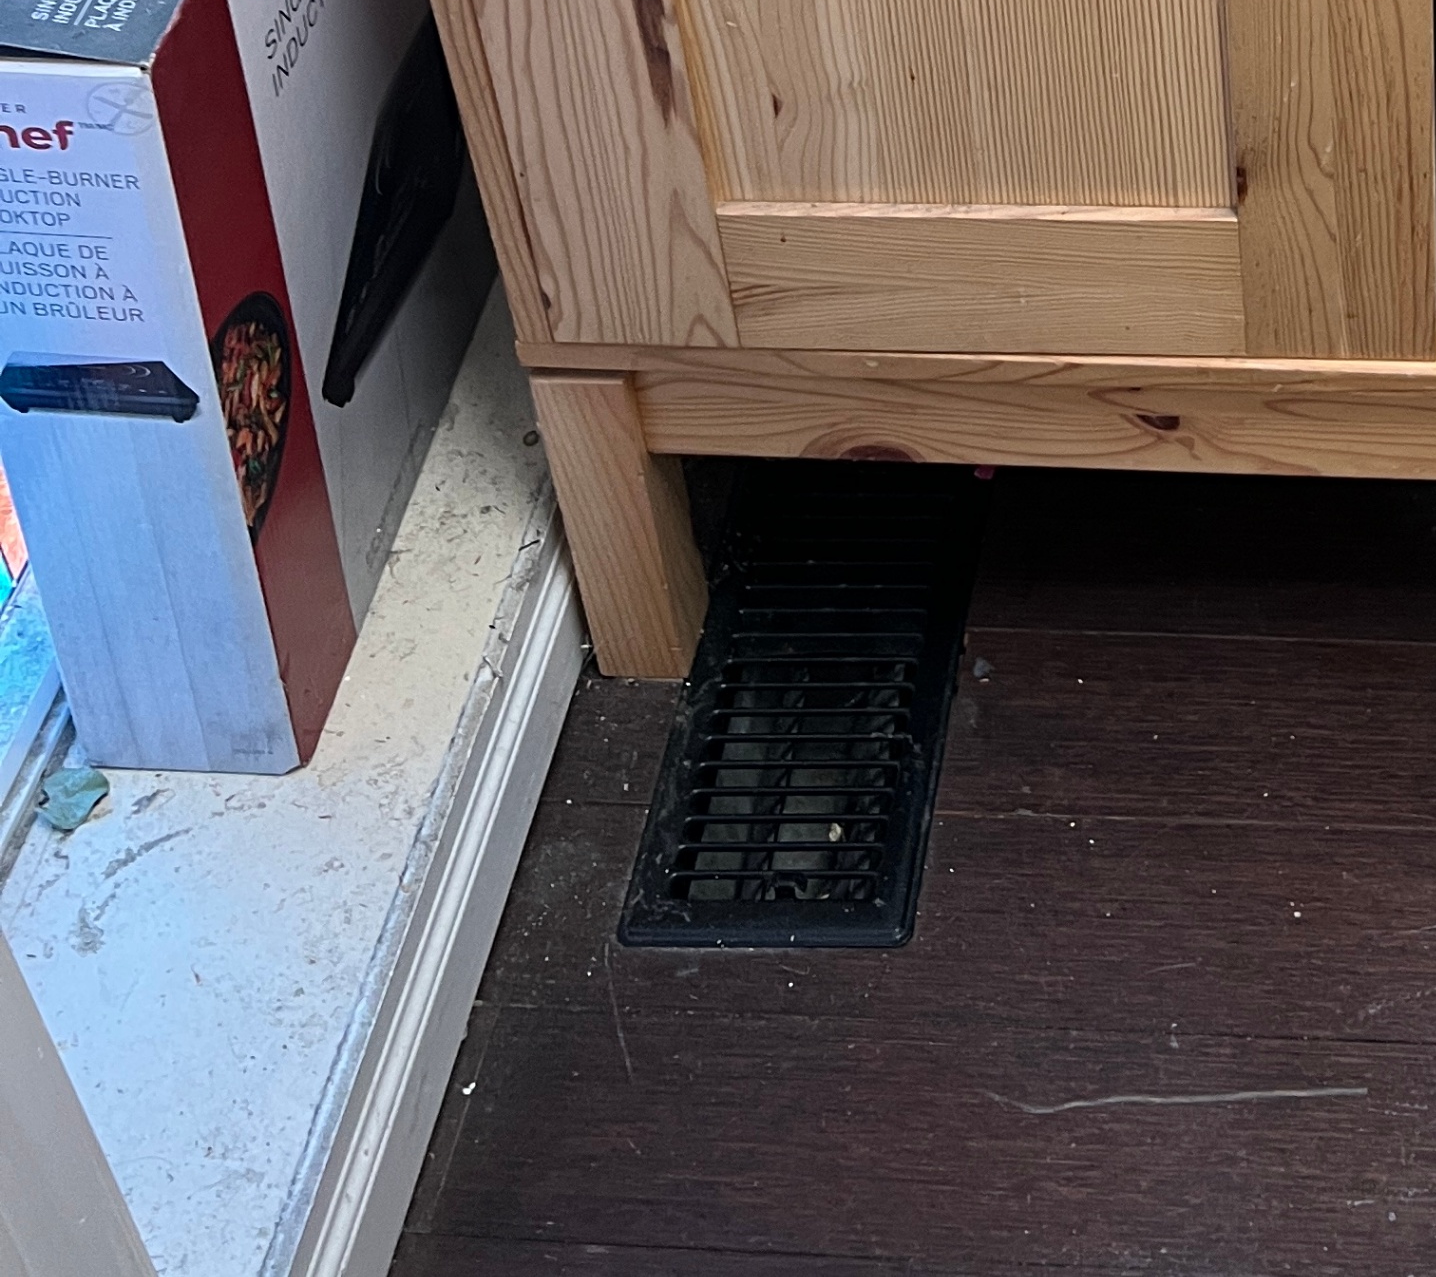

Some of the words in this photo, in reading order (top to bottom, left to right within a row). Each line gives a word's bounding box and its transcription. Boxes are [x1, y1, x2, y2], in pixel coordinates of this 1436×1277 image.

[78, 244, 110, 261] DE
[95, 262, 110, 280] À
[121, 284, 138, 303] À
[32, 301, 145, 323] BRÛLEUR
